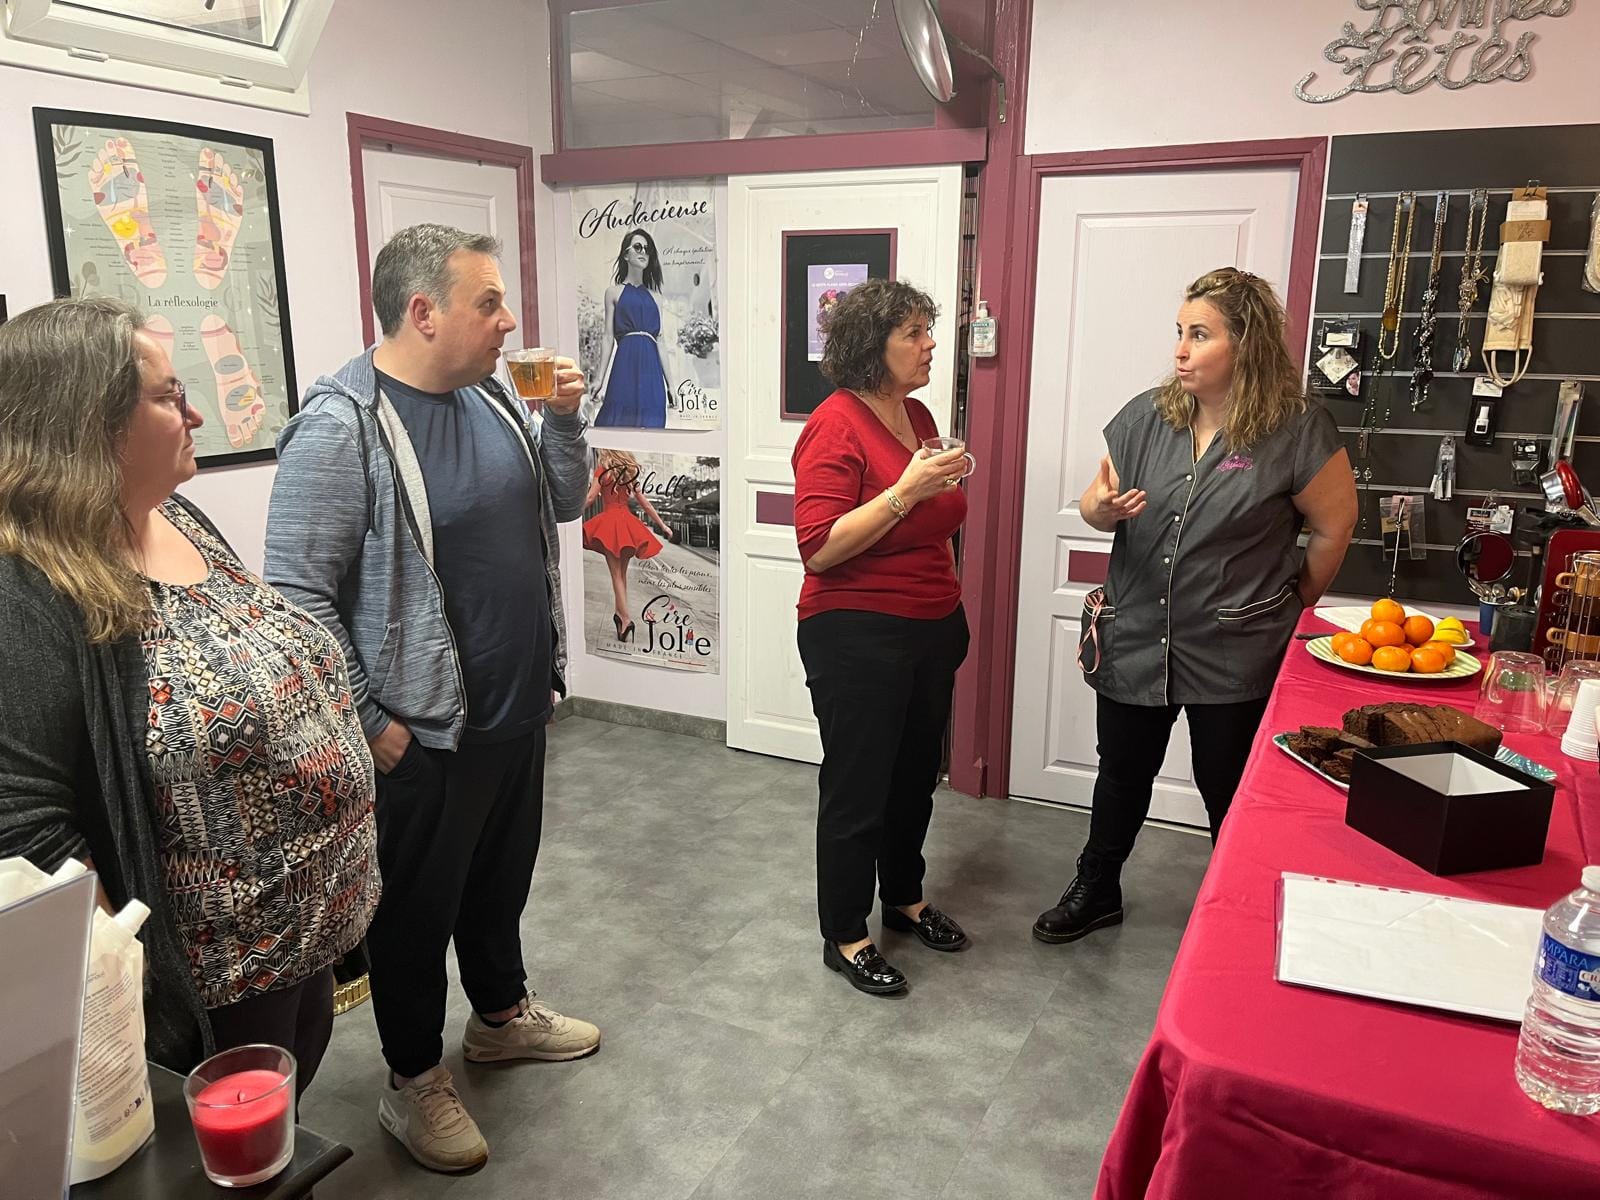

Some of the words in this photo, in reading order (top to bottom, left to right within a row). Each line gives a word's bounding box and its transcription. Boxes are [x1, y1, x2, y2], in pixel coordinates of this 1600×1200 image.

[579, 200, 707, 239] Audacieuse
[148, 295, 161, 307] La
[164, 295, 218, 309] réflexologie
[677, 379, 702, 396] Cire
[598, 463, 697, 499] Rebelle
[641, 594, 693, 626] Cire
